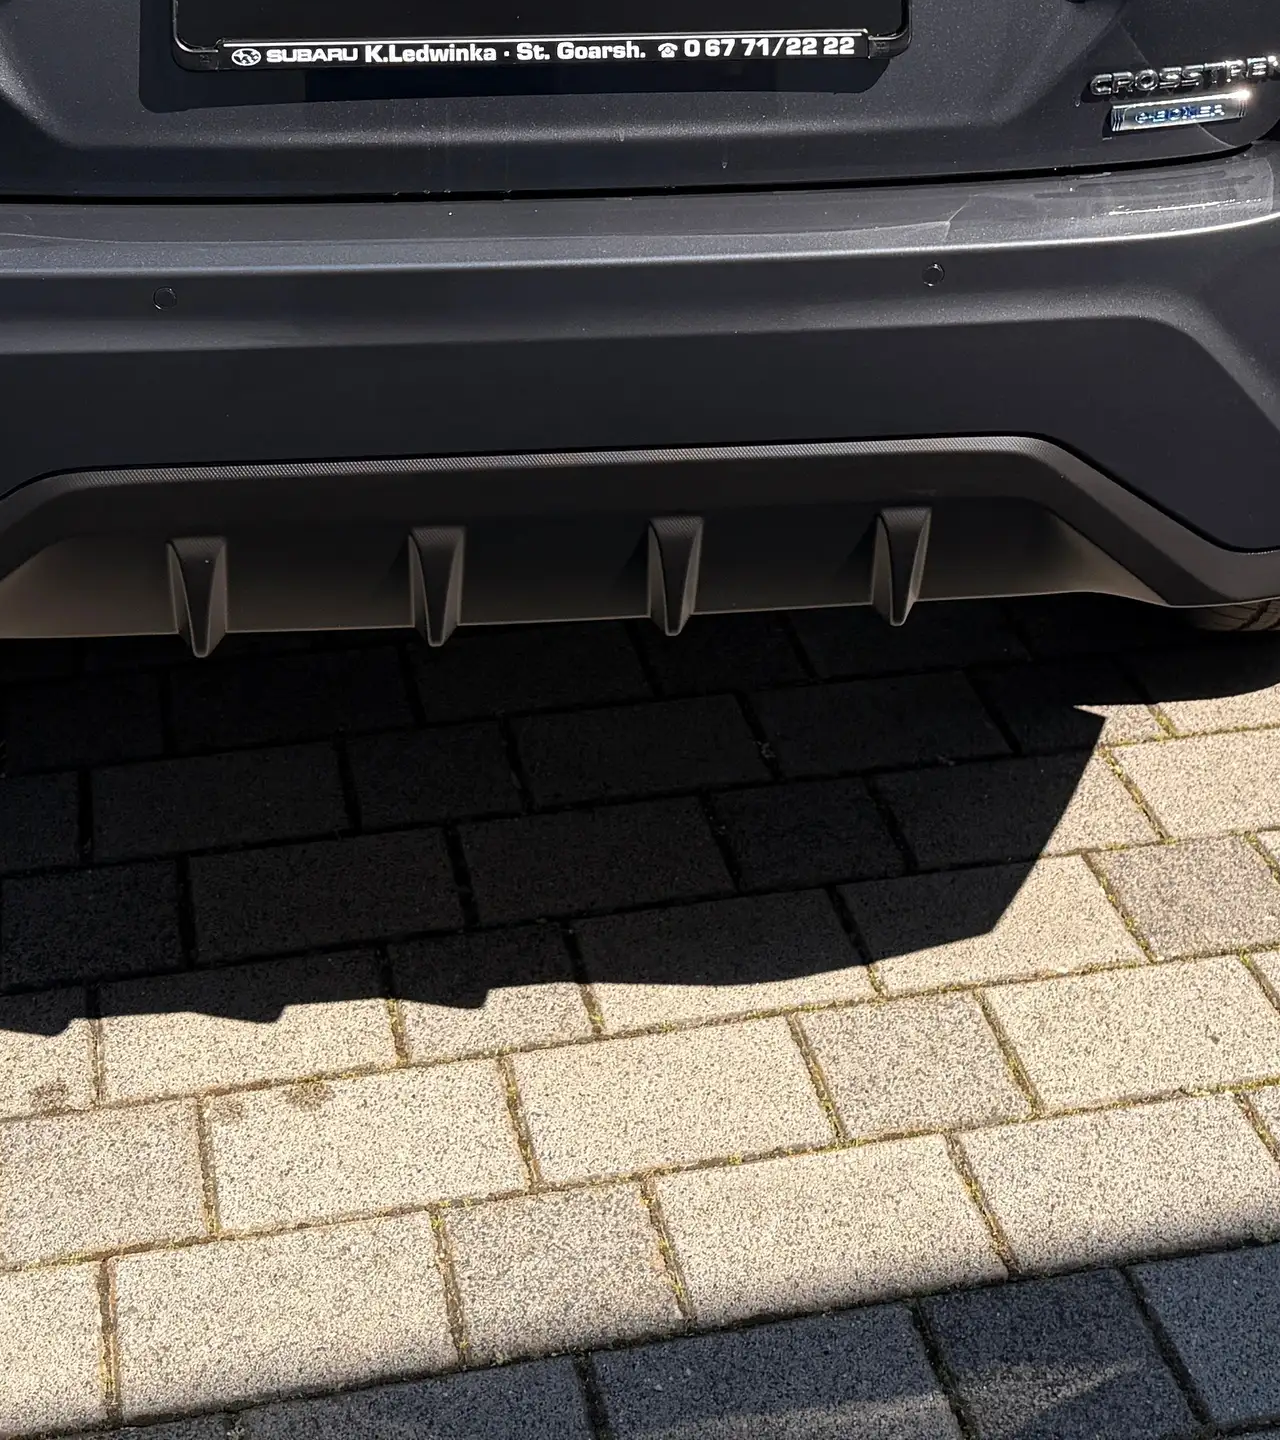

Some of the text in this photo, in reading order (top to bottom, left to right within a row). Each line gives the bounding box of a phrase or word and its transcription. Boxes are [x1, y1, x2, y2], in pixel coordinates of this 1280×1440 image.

[266, 47, 359, 63] SUBARU
[364, 43, 497, 63] K.Ledwinka
[516, 42, 551, 61] St.
[556, 40, 646, 60] Goarsh.
